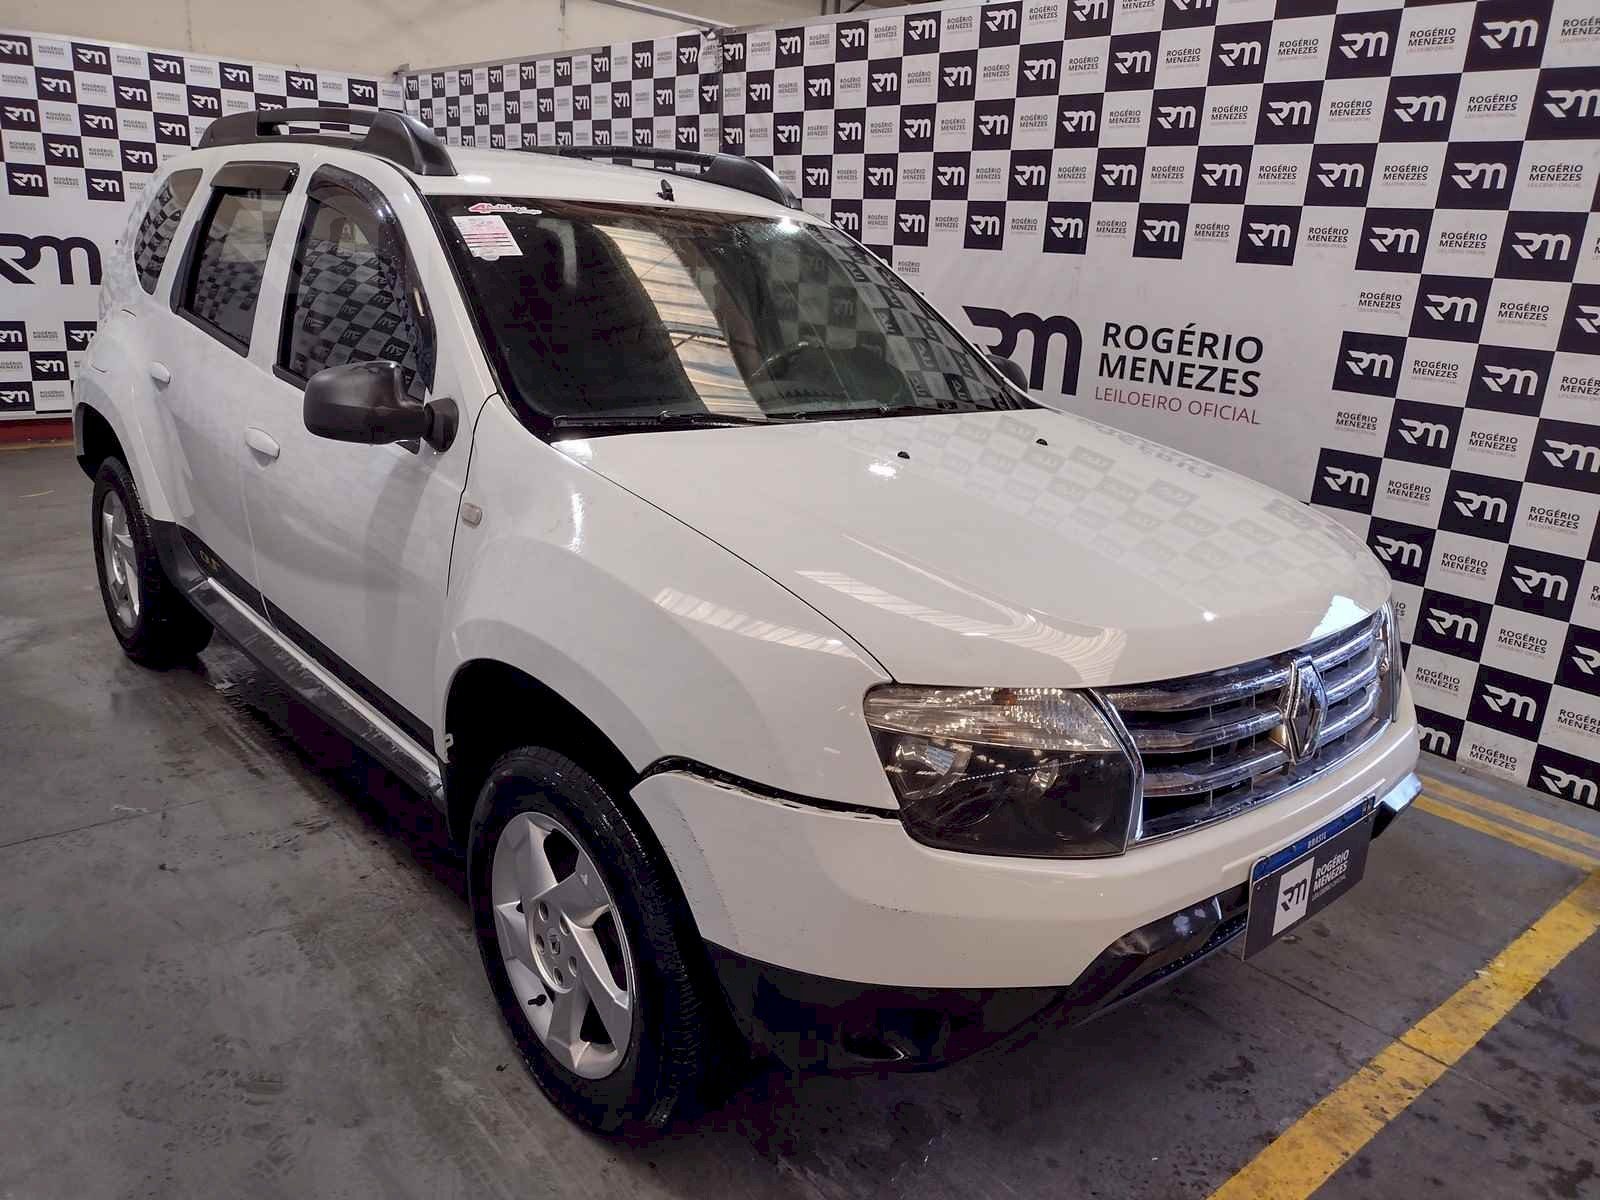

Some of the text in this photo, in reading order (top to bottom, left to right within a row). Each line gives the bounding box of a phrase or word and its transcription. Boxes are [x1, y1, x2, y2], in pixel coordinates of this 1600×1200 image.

[1121, 0, 1155, 10] MENEZES
[1408, 27, 1456, 38] ROGÉRIO
[1278, 38, 1319, 48] ROGÉRIO
[1407, 35, 1455, 46] MENEZES
[1166, 47, 1201, 57] ROGÉRIO
[1277, 45, 1318, 56] MENEZES
[1068, 55, 1099, 65] ROGÉRIO
[1165, 54, 1200, 64] MENEZES
[1068, 62, 1099, 71] MENEZES
[1468, 93, 1518, 104] ROGÉRIO
[1211, 104, 1248, 113] ROGÉRIO
[1330, 99, 1373, 109] ROGÉRIO
[1466, 102, 1517, 112] MENEZES
[1109, 109, 1141, 118] ROGÉRIO
[1210, 112, 1248, 120] MENEZES
[1328, 107, 1372, 117] MENEZES
[1108, 116, 1140, 124] MENEZES
[1057, 165, 1087, 173] ROGÉRIO
[1150, 164, 1185, 173] ROGÉRIO
[1258, 164, 1298, 173] ROGÉRIO
[1383, 163, 1429, 173] ROGÉRIO
[1530, 163, 1583, 173] ROGÉRIO
[1257, 172, 1297, 180] MENEZES
[1382, 172, 1428, 181] MENEZES
[1528, 173, 1582, 182] MENEZES
[1096, 219, 1127, 228] ROGÉRIO
[1194, 222, 1230, 231] ROGÉRIO
[1095, 226, 1126, 234] MENEZES
[1193, 229, 1229, 238] MENEZES
[1308, 226, 1349, 236] ROGÉRIO
[1307, 234, 1348, 243] MENEZES
[1440, 231, 1488, 241] ROGÉRIO
[1438, 239, 1487, 249] MENEZES
[1359, 291, 1402, 302] ROGÉRIO
[1357, 299, 1401, 309] MENEZES
[1499, 301, 1550, 313] ROGÉRIO
[1497, 309, 1548, 321] MENEZES
[1102, 322, 1264, 364] ROGÉRIO
[1413, 359, 1459, 371] ROGÉRIO
[1098, 352, 1262, 398] MENEZES
[1412, 367, 1458, 379] MENEZES
[1095, 386, 1261, 425] LEILOEIRO OFICIAL
[1336, 411, 1377, 423] ROGÉRIO
[1335, 418, 1376, 431] MENEZES
[1470, 430, 1518, 444] ROGÉRIO
[1468, 437, 1517, 452] MENEZES
[1387, 479, 1431, 494] ROGÉRIO
[1386, 486, 1430, 501] MENEZES
[1529, 505, 1580, 522] ROGÉRIO
[1527, 513, 1579, 530] MENEZES
[1442, 552, 1488, 568] ROGÉRIO
[1440, 559, 1487, 576] MENEZES
[1499, 628, 1548, 646] ROGÉRIO
[1497, 635, 1546, 654] MENEZES
[1416, 666, 1460, 685] ROGÉRIO
[1414, 673, 1459, 692] MENEZES
[1470, 743, 1517, 764] ROGÉRIO
[1469, 750, 1516, 771] MENEZES
[1315, 849, 1350, 879] ROGÉRIO
[1313, 861, 1348, 892] MENEZES
